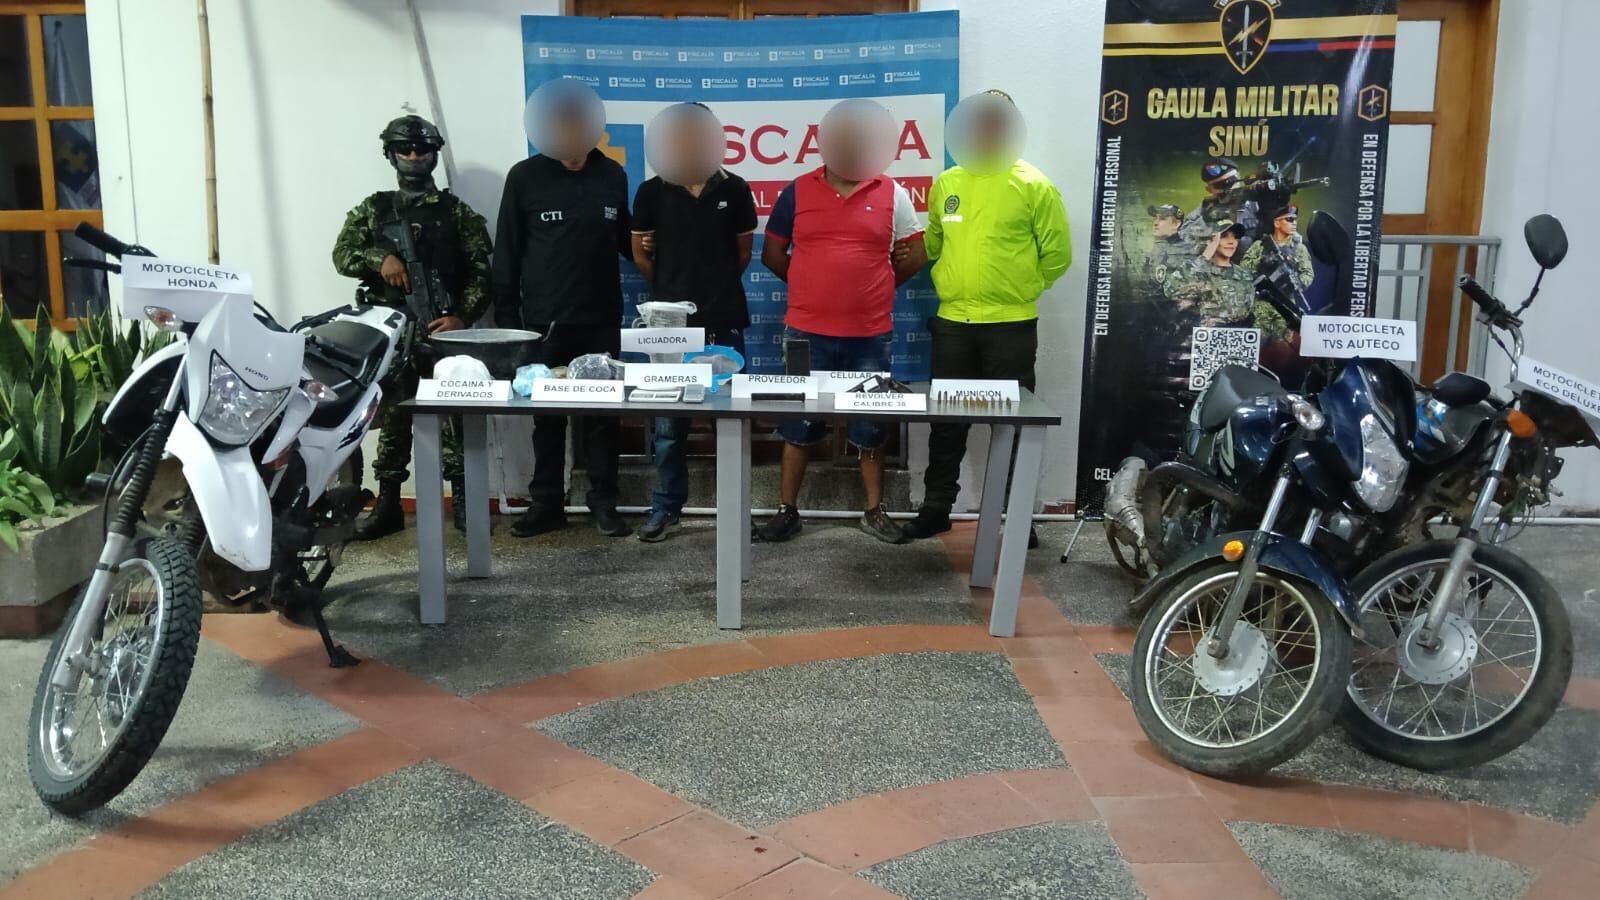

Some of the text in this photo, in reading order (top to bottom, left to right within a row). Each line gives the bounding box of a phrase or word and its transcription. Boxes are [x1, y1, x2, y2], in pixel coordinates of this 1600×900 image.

[1146, 84, 1339, 119] GAULA MILITAR
[1208, 118, 1269, 157] SINÚ
[540, 210, 563, 222] CTI
[1350, 133, 1378, 317] EN DEFENSA POR LA LIBERTAD PERS
[1094, 135, 1122, 336] EN DEFENSA POR LA LIBERTAD PERSONAL
[142, 263, 240, 281] MOTOCICLETA
[167, 278, 217, 289] HONDA
[1318, 323, 1405, 336] MOTOCICLETA
[637, 336, 688, 345] LICUADORA
[1322, 339, 1400, 350] TVS AUTECO
[643, 374, 697, 384] GRAMERAS
[748, 374, 807, 385] PROVEEDOR
[830, 371, 872, 379] CELULAR
[440, 379, 494, 388] COCAINA Y
[1533, 365, 1600, 400] MOTOCICLET
[1536, 378, 1560, 394] ECO
[436, 390, 494, 399] DERIVADOS
[543, 384, 617, 394] BASE DE COCA
[955, 389, 1001, 398] MUNICION
